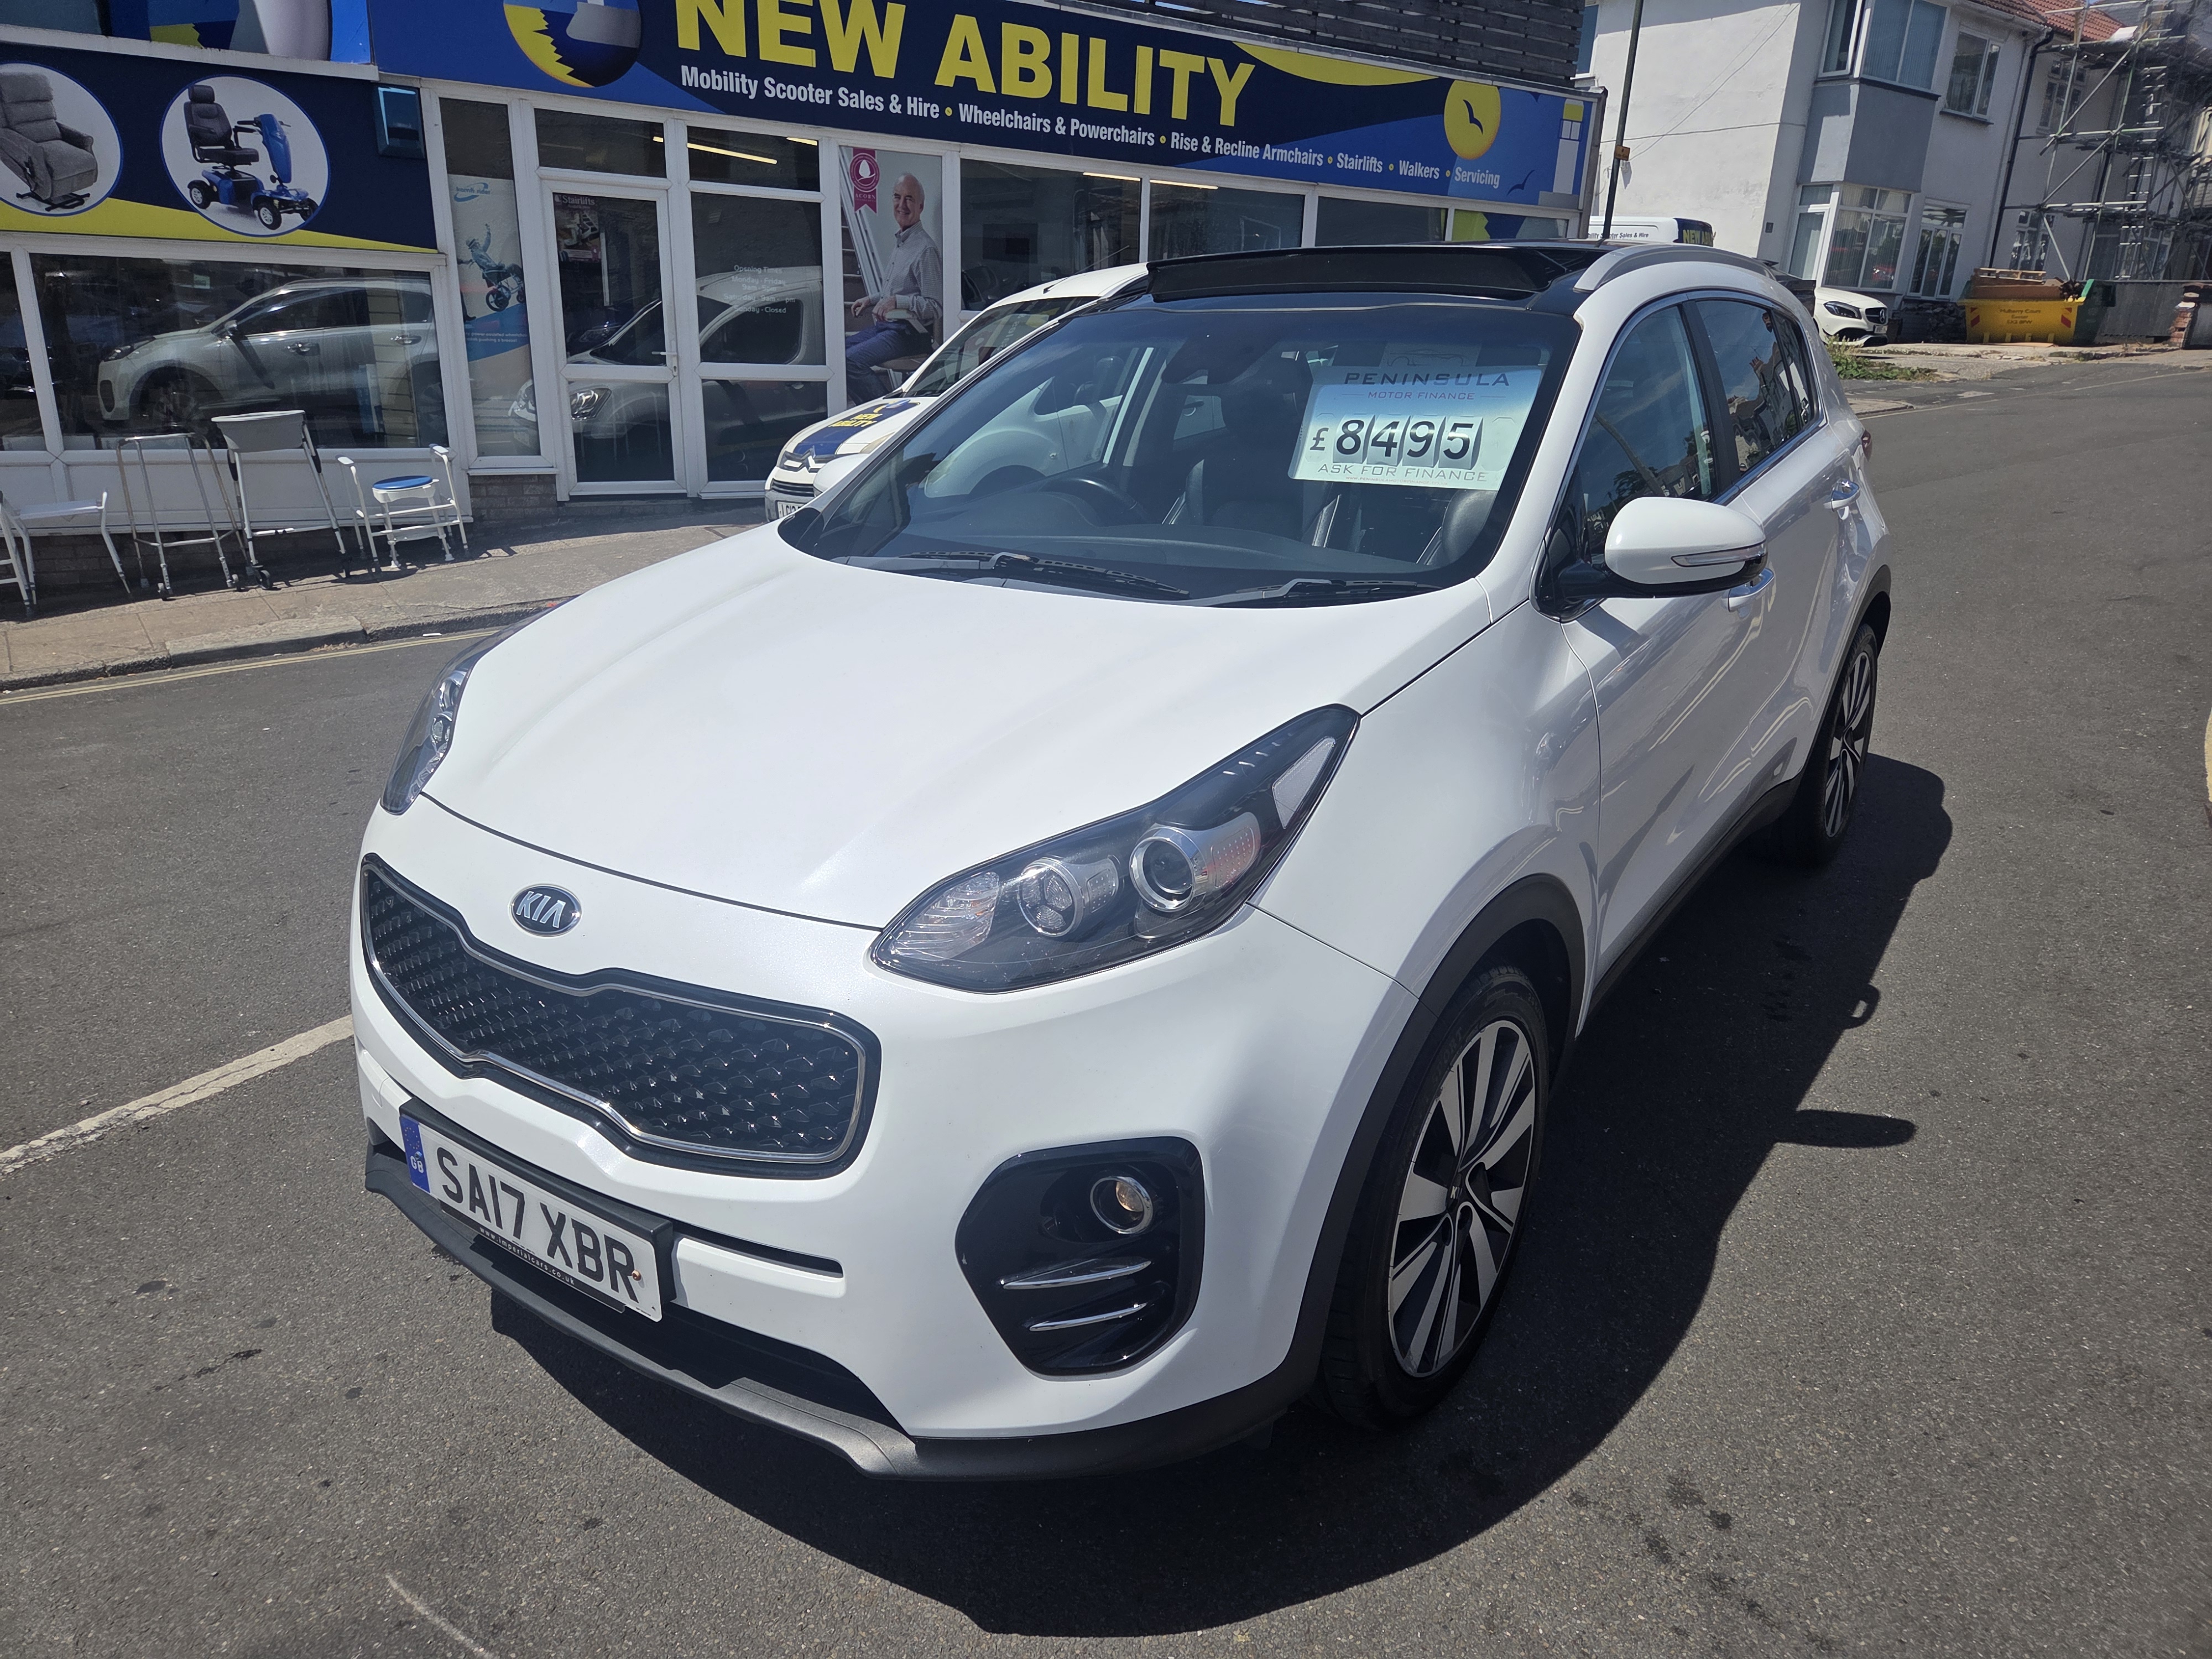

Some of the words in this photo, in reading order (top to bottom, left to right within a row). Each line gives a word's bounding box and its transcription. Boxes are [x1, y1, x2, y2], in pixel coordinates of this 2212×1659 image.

[675, 0, 906, 79] NEW
[935, 13, 1256, 127] ABILITY
[681, 65, 758, 100] Mobility
[764, 76, 833, 105] Scooter
[838, 87, 884, 112] Sales
[889, 93, 902, 114] &
[907, 96, 940, 118] Hire
[958, 103, 1051, 133] Wheelchairs
[1055, 116, 1066, 135] &
[1070, 118, 1155, 147] Powerchairs
[1170, 132, 1198, 152] Rise
[1201, 135, 1212, 153] &
[1214, 137, 1260, 159] Recline
[1262, 144, 1324, 166] Armchairs
[1336, 152, 1383, 173] Stairlifts
[1399, 160, 1440, 180] Walkers
[1454, 166, 1500, 189] Servicing
[562, 195, 595, 206] Stairlifts
[1683, 229, 1700, 244] NEW
[734, 265, 762, 274] Opening
[732, 276, 759, 284] Monday
[764, 278, 786, 286] Friday
[1344, 372, 1510, 387] PENINSULA
[1368, 391, 1413, 399] MOTOR
[1417, 392, 1475, 400] FINANCE
[1317, 463, 1353, 474] ASK
[1360, 466, 1397, 477] FOR
[1404, 468, 1489, 482] FINANCE
[515, 891, 566, 928] KIA
[409, 1155, 425, 1174] GB
[436, 1146, 526, 1240] SA17
[539, 1202, 640, 1305] XBR
[479, 1226, 575, 1286] www.imperialcars.co.uk
